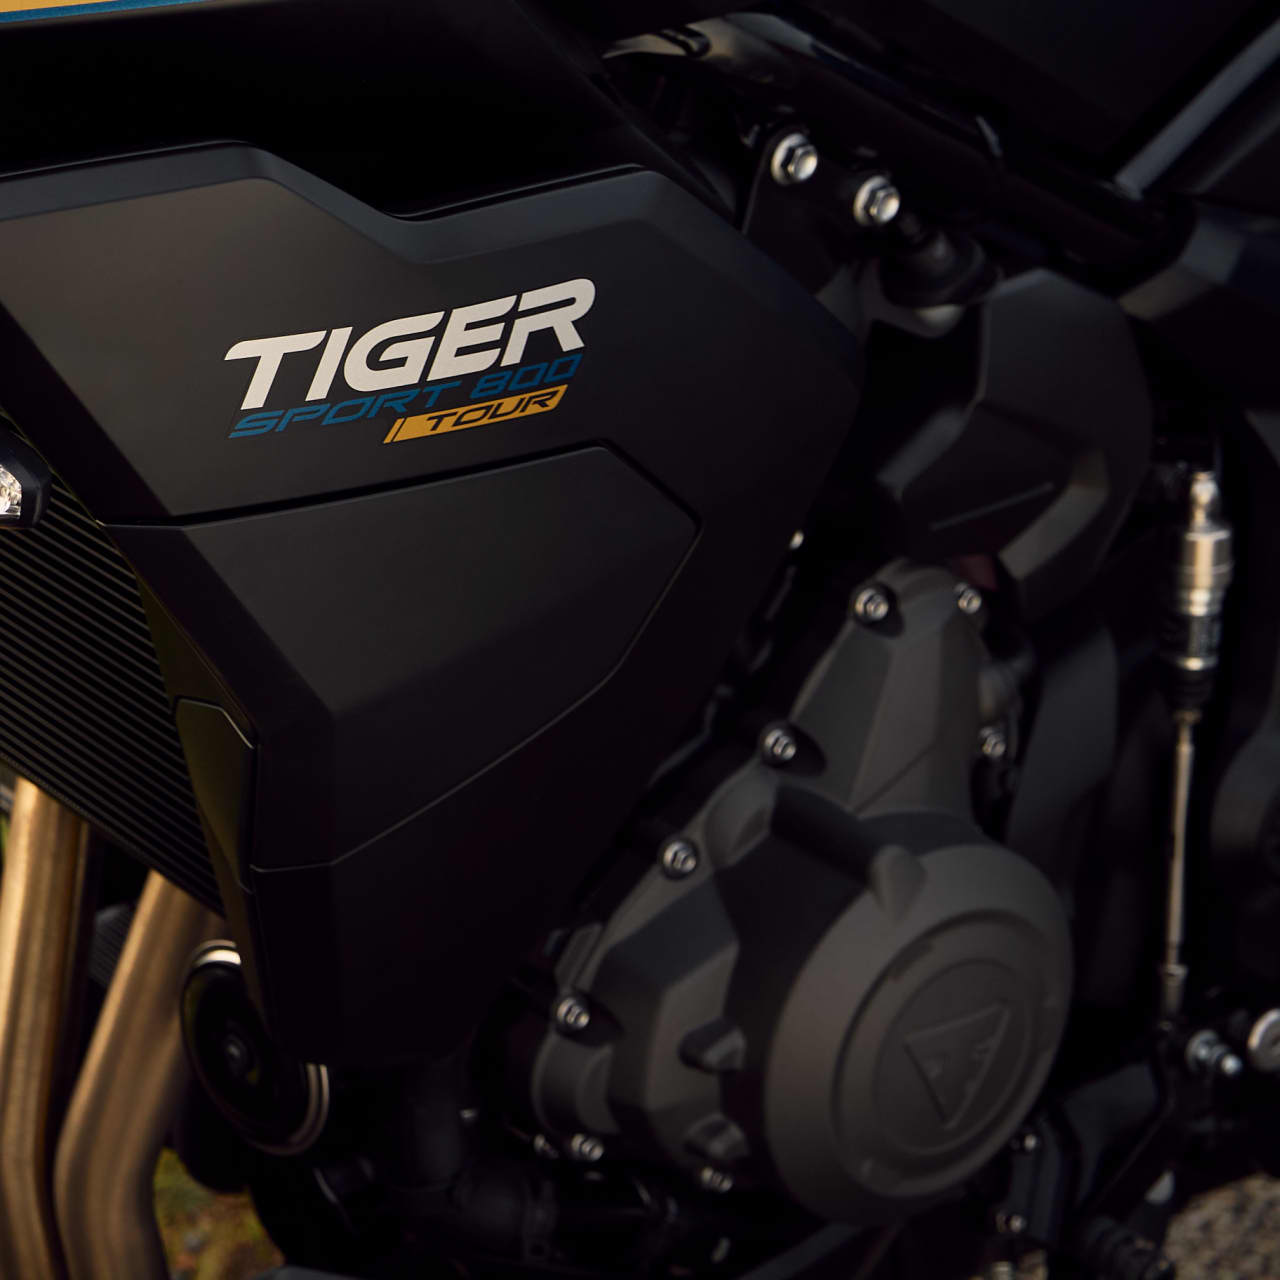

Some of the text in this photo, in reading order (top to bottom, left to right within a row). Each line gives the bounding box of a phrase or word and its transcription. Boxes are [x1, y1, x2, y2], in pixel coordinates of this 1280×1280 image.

[224, 278, 595, 410] TIGER
[229, 353, 583, 438] SPORT 800
[427, 393, 558, 431] TOUR
